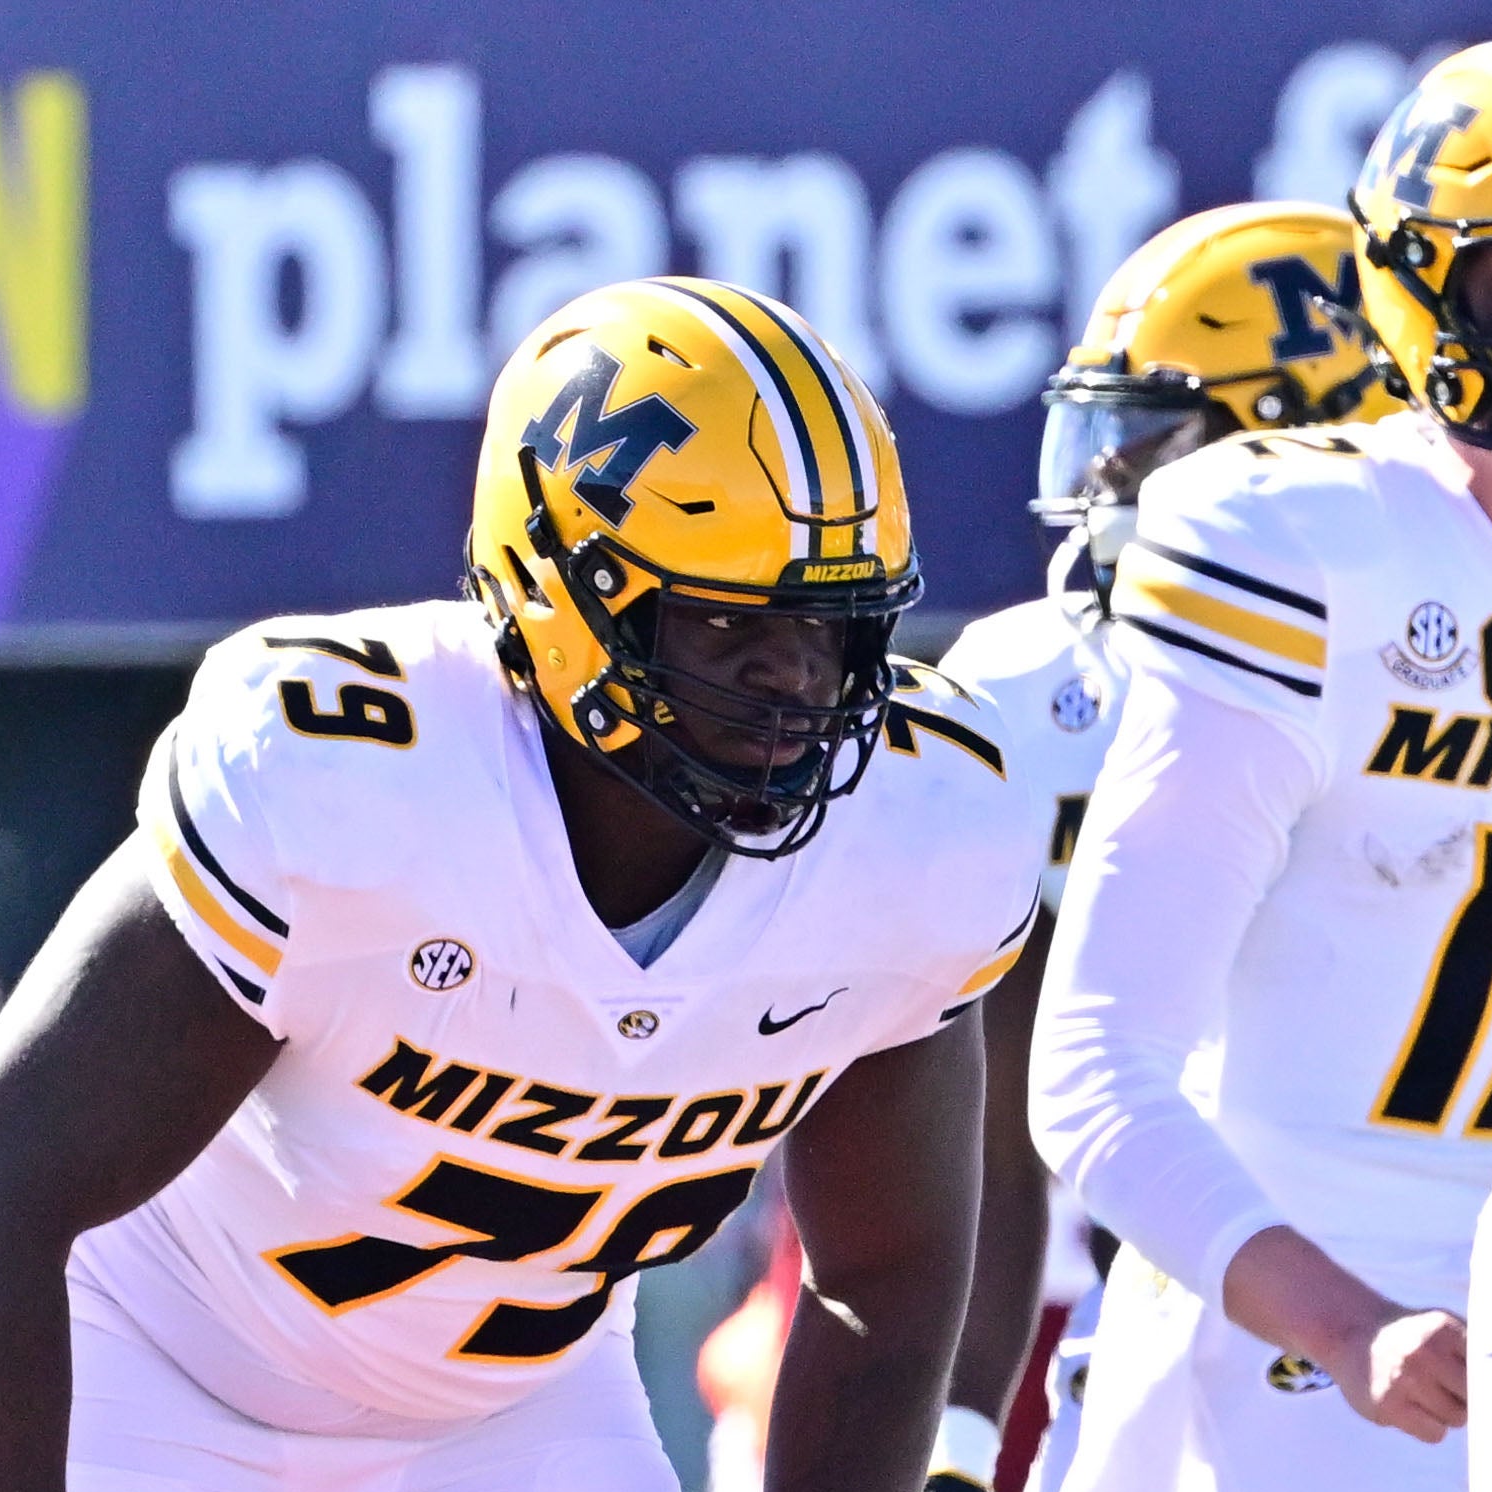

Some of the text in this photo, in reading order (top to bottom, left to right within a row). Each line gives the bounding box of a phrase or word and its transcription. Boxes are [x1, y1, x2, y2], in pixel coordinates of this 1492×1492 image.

[166, 62, 1176, 518] planet
[519, 344, 701, 530] M
[802, 560, 876, 583] MIZZOU
[1392, 656, 1468, 691] GRADUATE
[1407, 602, 1458, 662] SEC
[261, 635, 420, 752] 79
[410, 939, 474, 991] SEC
[357, 1034, 832, 1165] MIZZOU
[262, 1152, 762, 1364] 79
